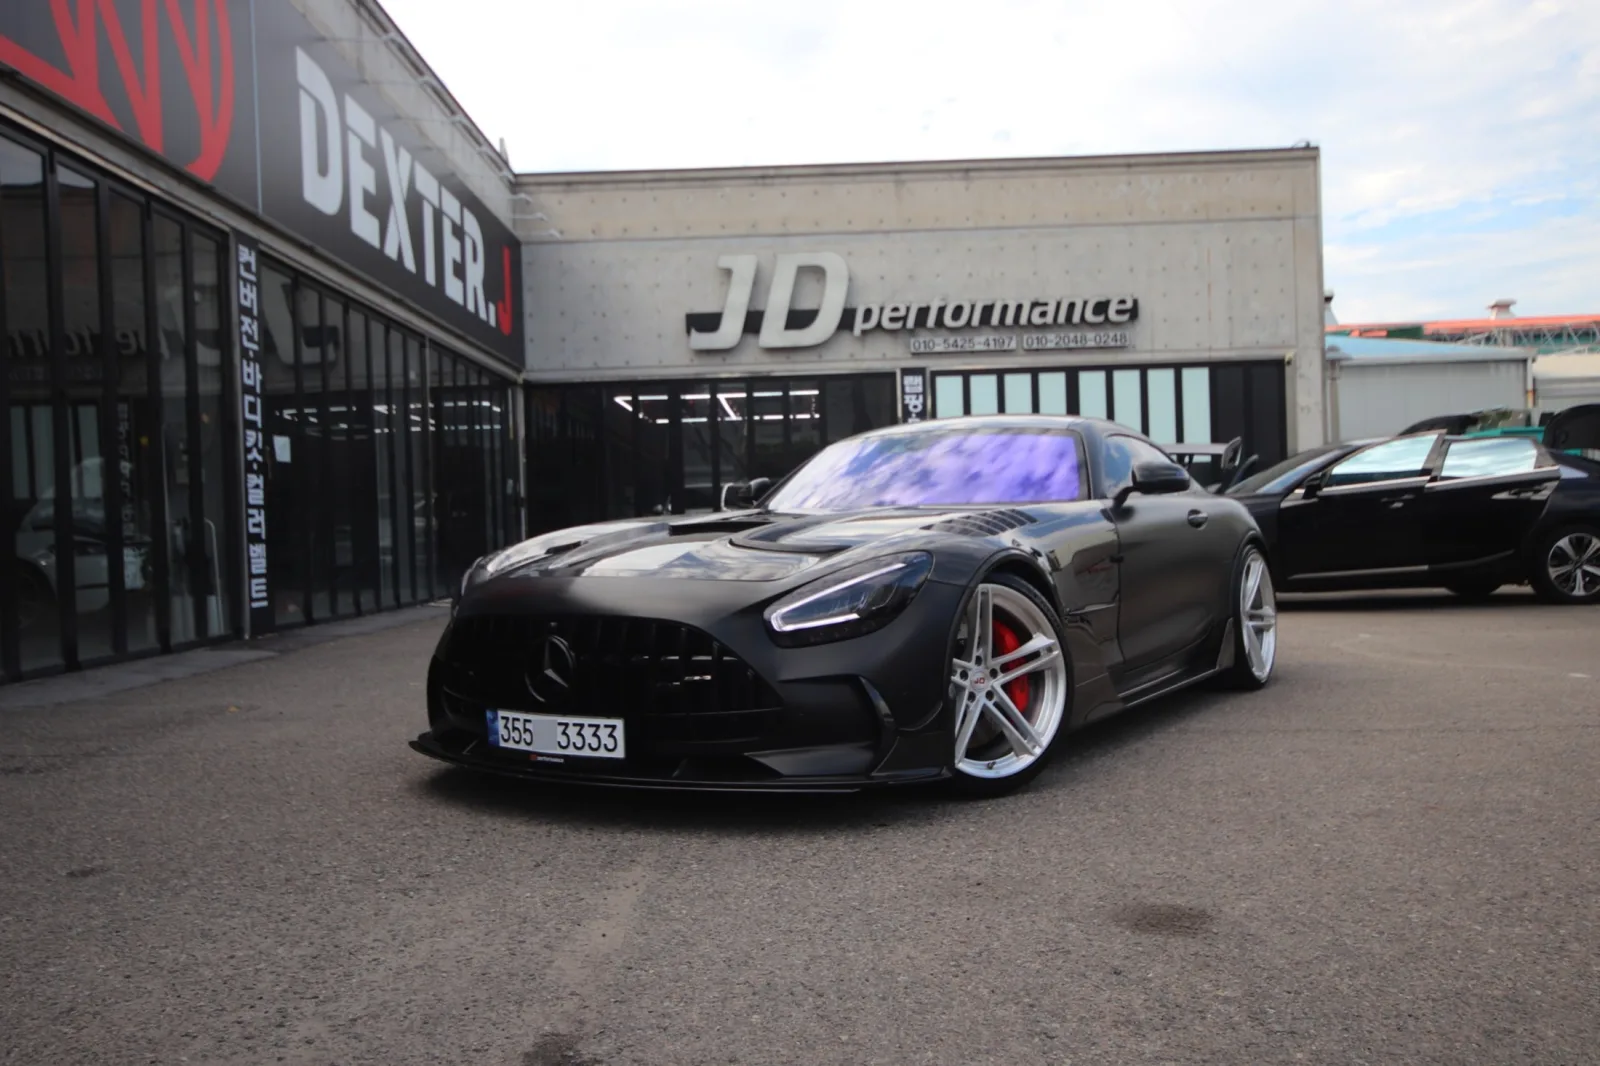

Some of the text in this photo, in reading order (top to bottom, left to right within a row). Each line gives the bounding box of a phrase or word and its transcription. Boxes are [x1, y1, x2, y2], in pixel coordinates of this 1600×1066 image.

[690, 251, 1133, 350] JD performance
[912, 333, 1128, 351] 010-5425-4197 010-2048-0248
[500, 715, 618, 752] 355 3333
